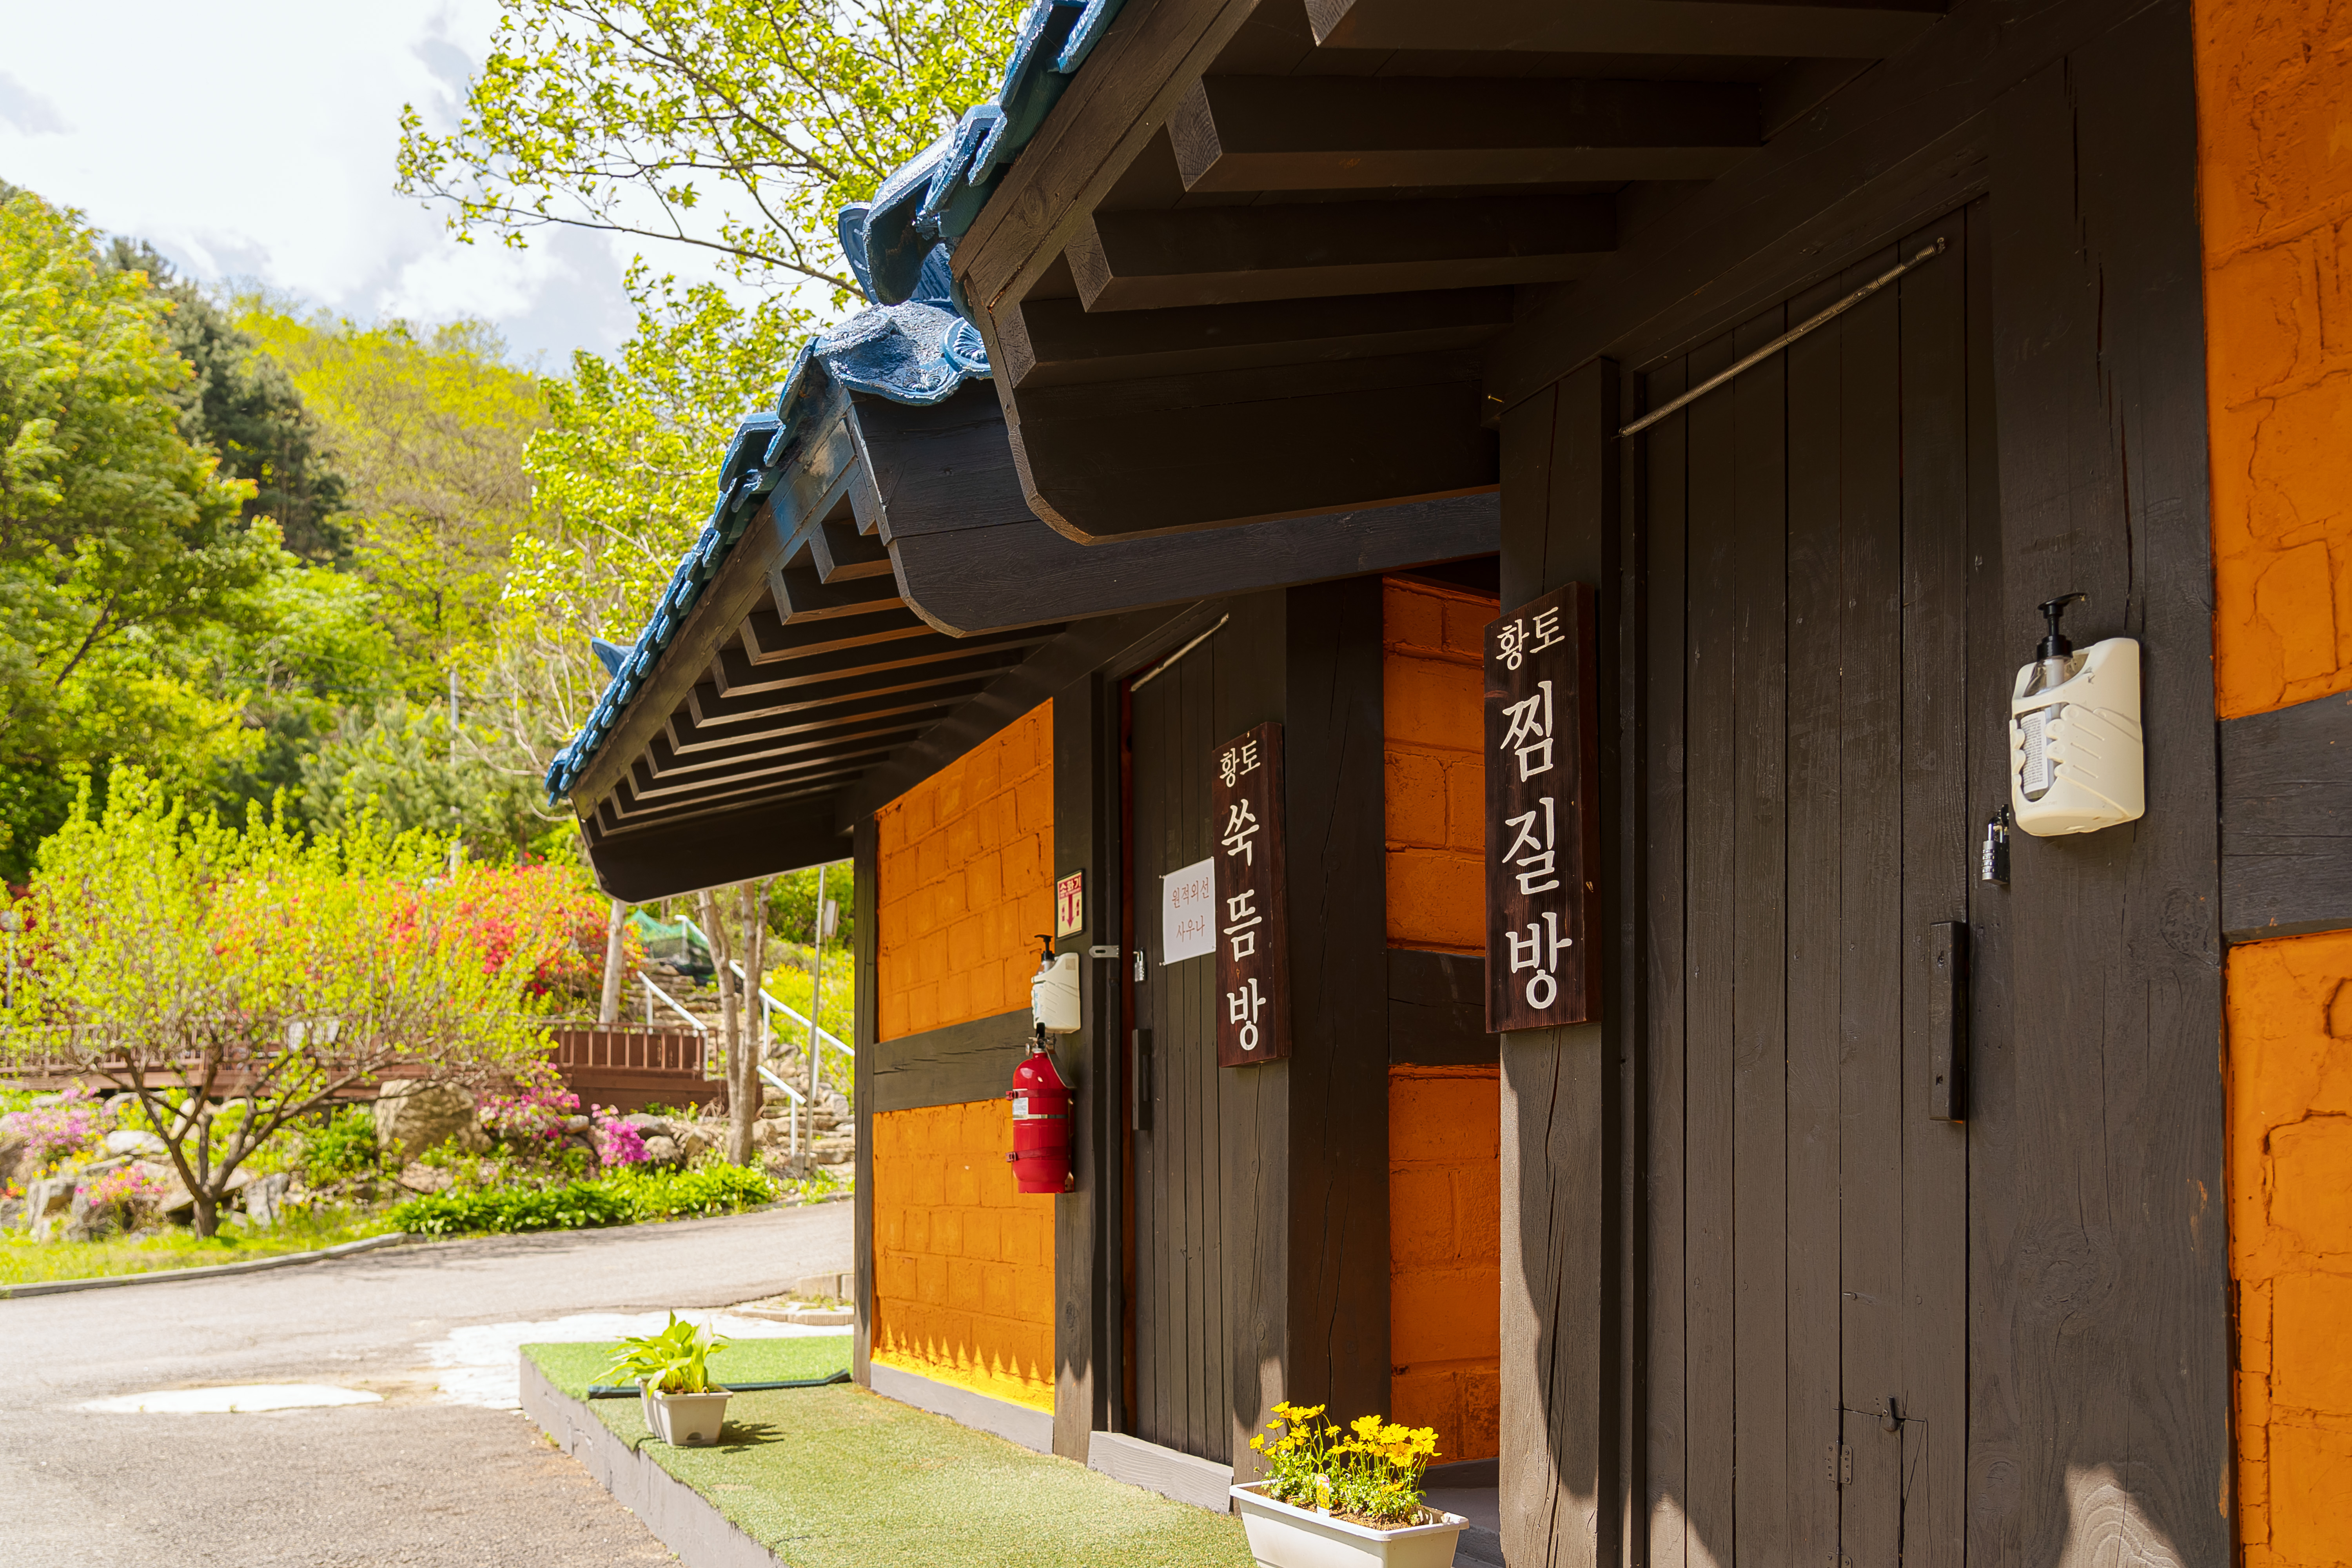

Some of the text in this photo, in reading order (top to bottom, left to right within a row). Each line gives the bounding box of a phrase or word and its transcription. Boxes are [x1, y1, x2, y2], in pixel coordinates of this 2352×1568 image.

[1495, 606, 1566, 671] 황토
[1219, 740, 1261, 788] 황토
[1499, 680, 1573, 1010] 찜질방
[1060, 877, 1081, 894] 소화기
[1172, 877, 1209, 909] 원적외선
[1176, 915, 1205, 943] 사우나
[1221, 798, 1267, 1051] 쑥뜸방
